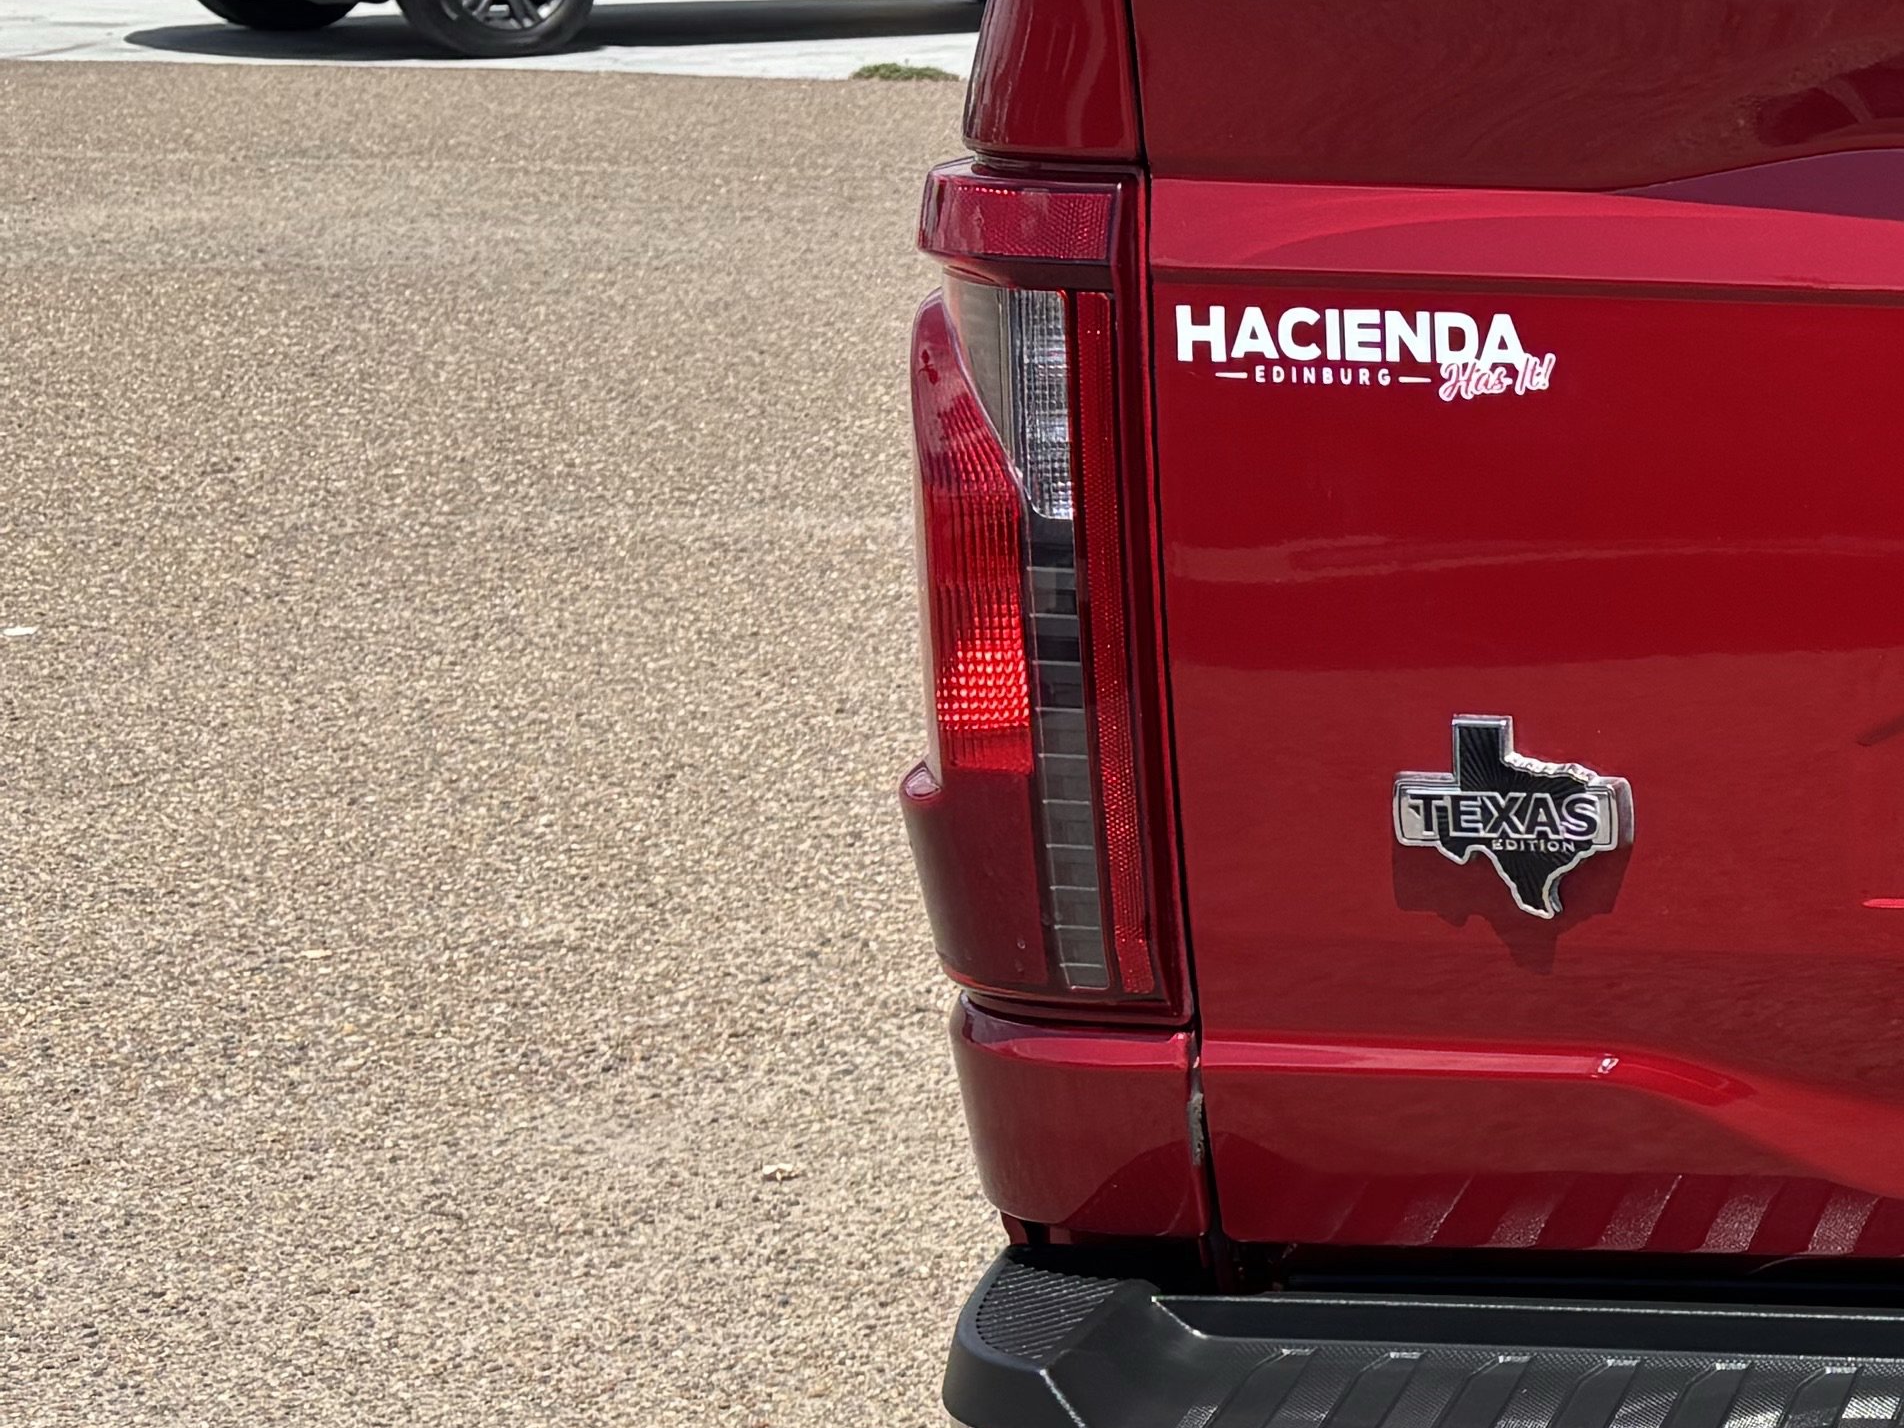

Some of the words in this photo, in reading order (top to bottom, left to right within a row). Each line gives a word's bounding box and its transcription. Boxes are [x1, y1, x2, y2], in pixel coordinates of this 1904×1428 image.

[1175, 304, 1526, 364] HACIENDA
[1255, 365, 1392, 387] EDINBURG
[1438, 361, 1511, 402] Has
[1513, 352, 1557, 395] It!
[1406, 789, 1600, 841] TEXAS
[1491, 838, 1576, 853] EDITION
